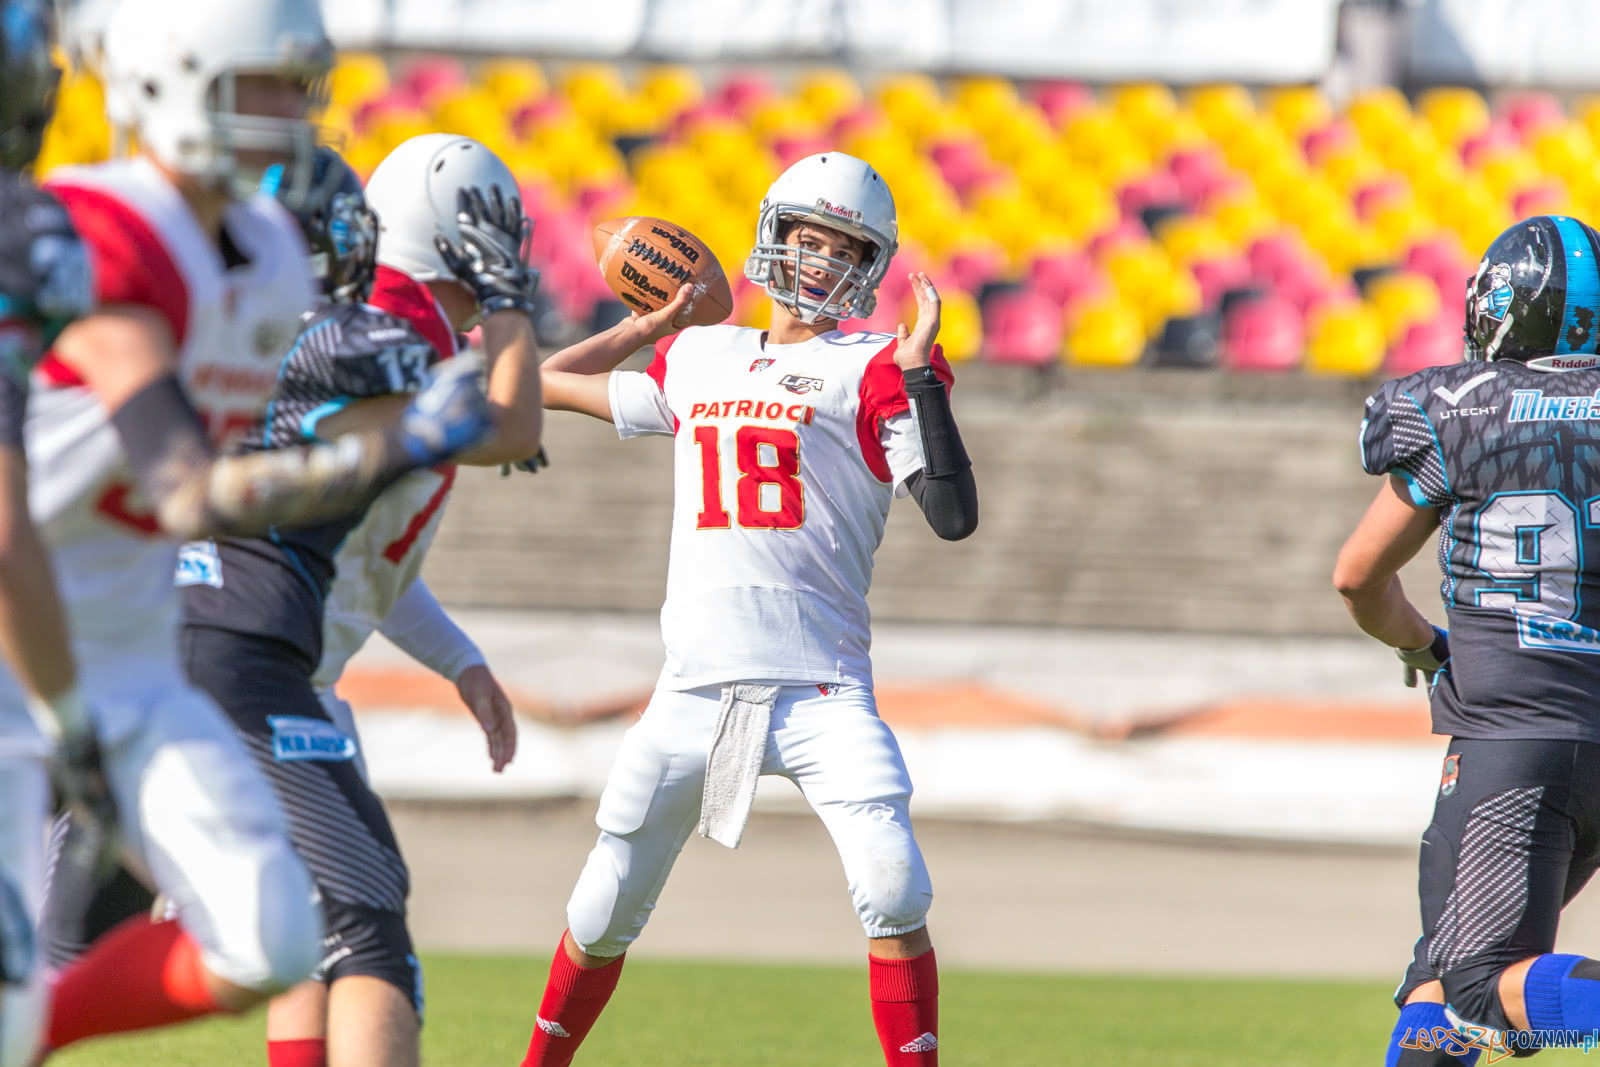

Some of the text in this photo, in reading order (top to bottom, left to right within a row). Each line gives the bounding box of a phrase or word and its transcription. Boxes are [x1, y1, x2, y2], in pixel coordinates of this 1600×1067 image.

[824, 202, 853, 218] Riddell
[651, 226, 700, 264] Wilson
[621, 261, 669, 302] Wilson
[1551, 358, 1597, 369] Riddell
[778, 374, 824, 393] LFA
[690, 400, 815, 426] PATRIOCI
[1439, 406, 1499, 420] UTECHT
[693, 425, 805, 530] 18
[1473, 489, 1600, 623] 9
[1528, 619, 1600, 645] KRA
[900, 1043, 938, 1053] adida
